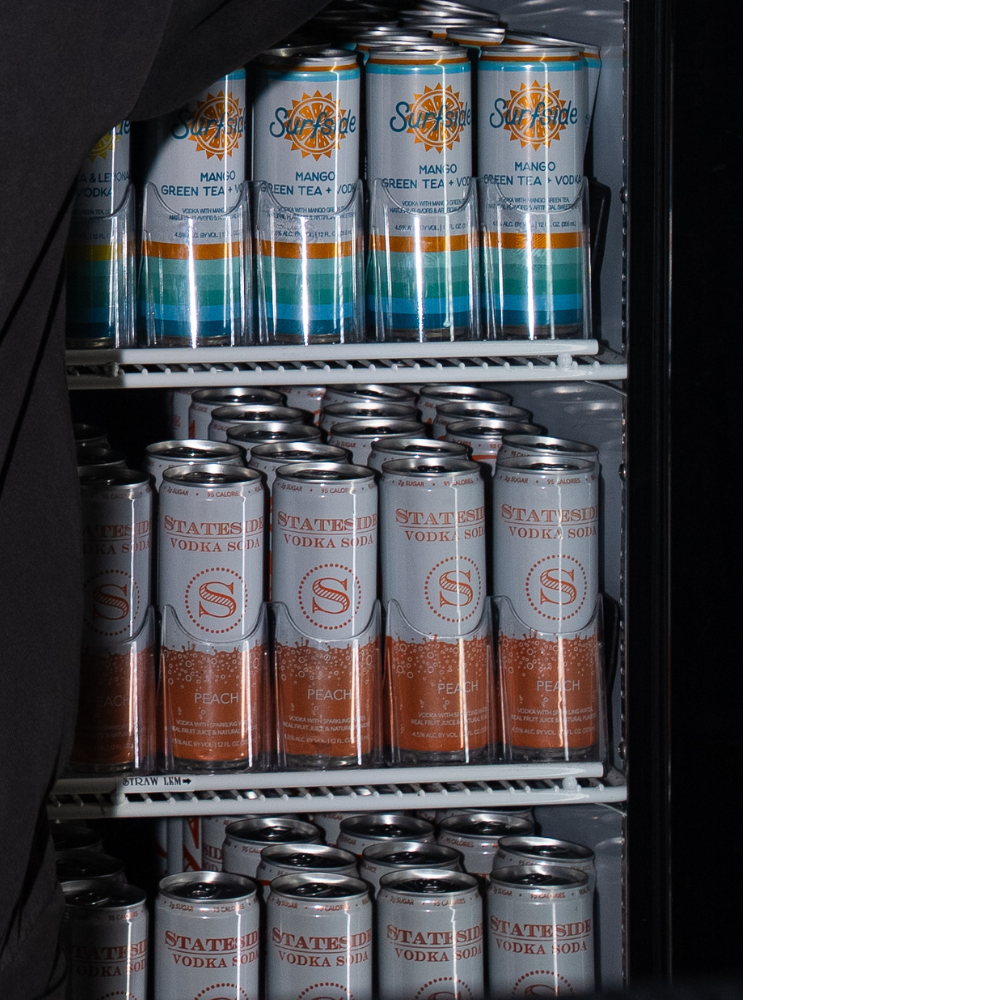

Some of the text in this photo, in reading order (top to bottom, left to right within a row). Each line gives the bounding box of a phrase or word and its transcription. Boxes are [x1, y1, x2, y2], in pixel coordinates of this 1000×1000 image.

[389, 101, 472, 133] Surfside
[489, 98, 578, 129] Surfside
[269, 107, 357, 139] Surfside
[419, 163, 458, 175] MANGO
[514, 161, 557, 172] MANGO
[89, 172, 97, 183] &
[200, 170, 236, 182] MANGO
[295, 171, 336, 181] MANGO
[517, 175, 543, 186] TEA
[161, 185, 199, 197] GREEN
[202, 186, 226, 197] TEA
[298, 185, 323, 196] TEA
[421, 179, 446, 189] TEA
[164, 514, 264, 536] STATESIDE
[277, 510, 377, 532] STATESIDE
[404, 530, 460, 542] VODKA
[509, 525, 598, 540] VODKA SODA
[170, 537, 260, 552] VODKA SODA
[284, 533, 374, 548] VODKA SODA
[438, 569, 474, 607] S
[539, 568, 578, 605] S
[92, 583, 130, 621] S
[199, 580, 237, 619] S
[311, 577, 350, 615] S
[437, 680, 479, 695] PEACH
[536, 679, 581, 692] PEACH
[193, 692, 239, 704] PEACH
[306, 688, 353, 701] PEACH
[122, 776, 182, 787] STRAW LEM
[490, 914, 593, 938] STATESIDE
[272, 926, 372, 950] STATESIDE
[496, 938, 588, 955] VODKA SODA
[172, 953, 228, 968] VODKA
[278, 950, 369, 967] VODKA SODA
[395, 947, 450, 962] VODKA
